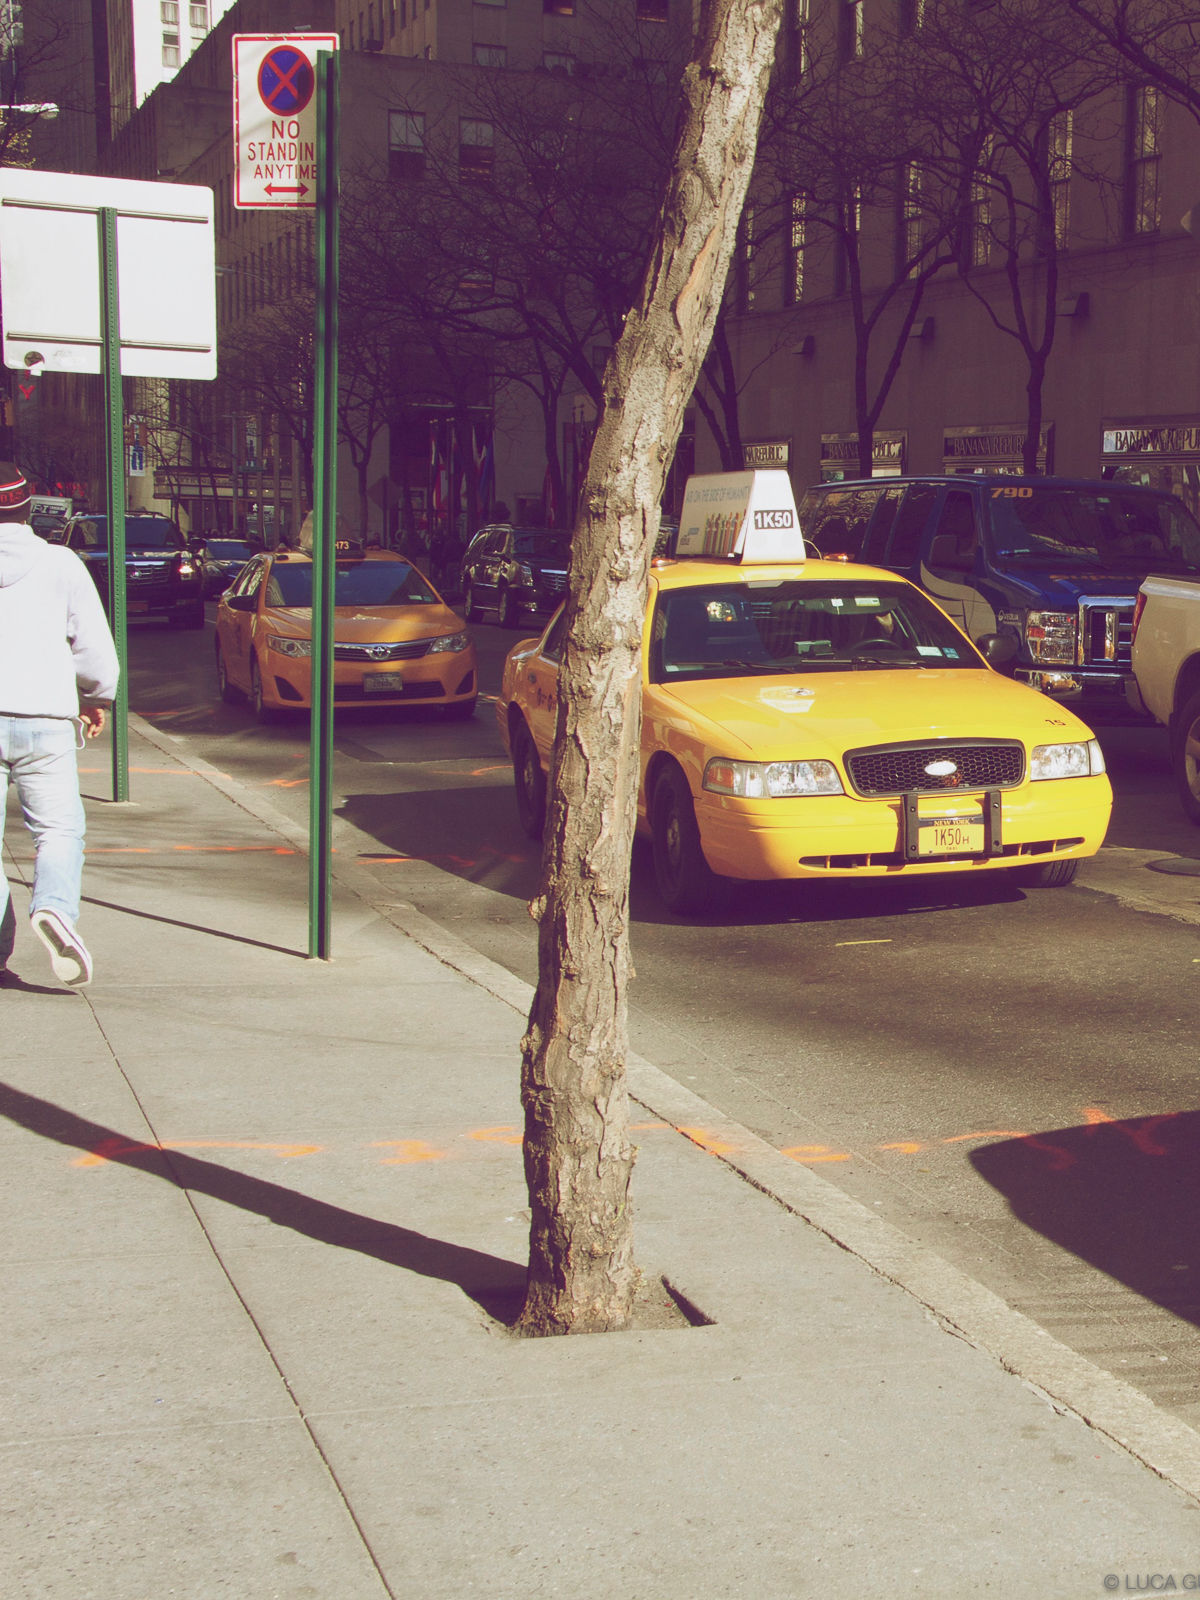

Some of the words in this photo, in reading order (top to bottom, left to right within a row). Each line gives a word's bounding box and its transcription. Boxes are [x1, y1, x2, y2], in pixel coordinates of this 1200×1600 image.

[272, 120, 300, 139] NO
[248, 142, 314, 161] STANDIN
[254, 164, 317, 180] ANYTIME
[954, 437, 991, 456] BANANA
[993, 434, 1024, 455] REPUB
[1115, 430, 1165, 451] BANANA
[990, 487, 1033, 498] 790
[755, 511, 792, 528] 1K50
